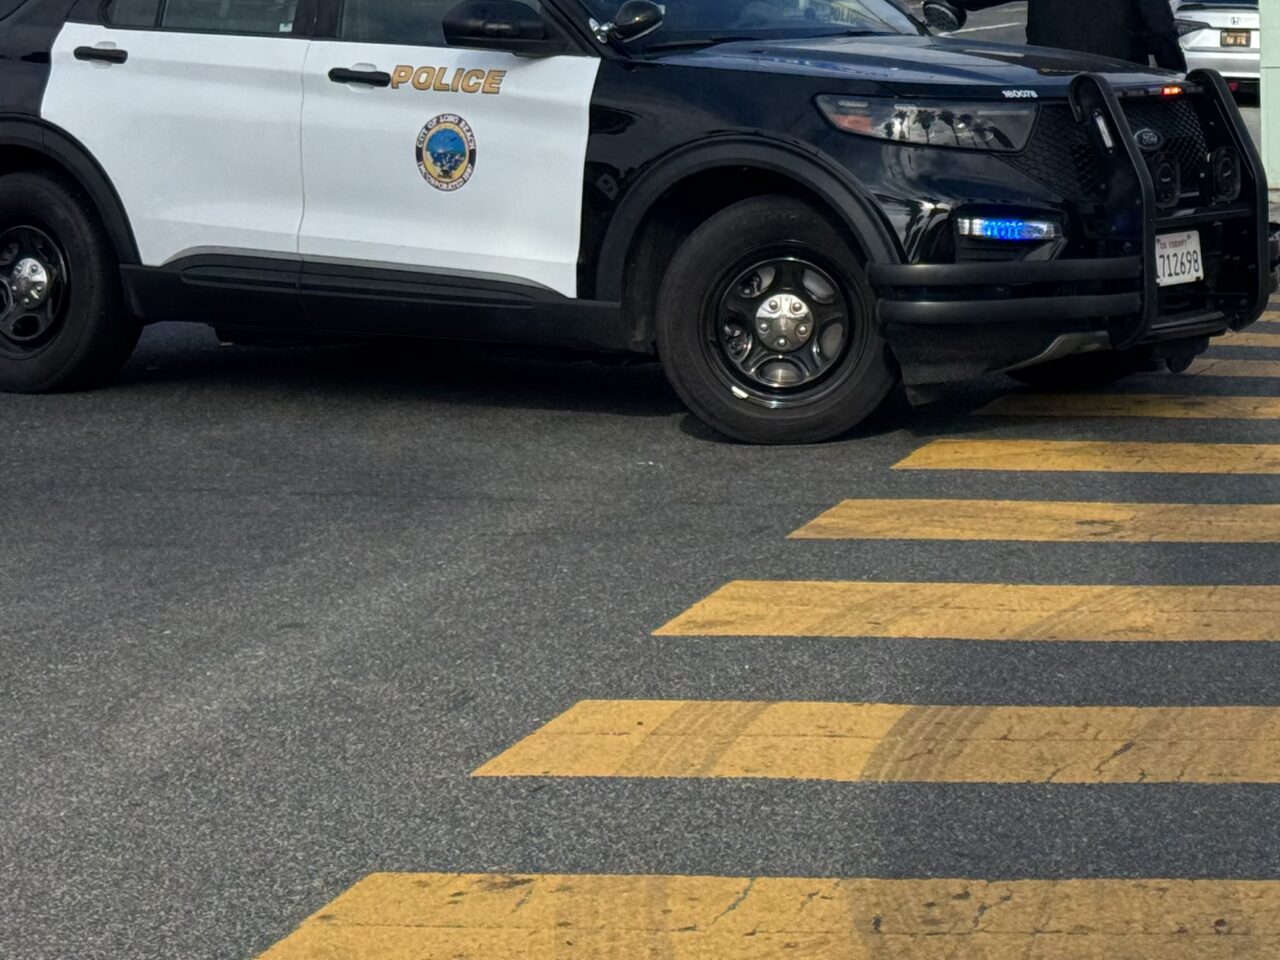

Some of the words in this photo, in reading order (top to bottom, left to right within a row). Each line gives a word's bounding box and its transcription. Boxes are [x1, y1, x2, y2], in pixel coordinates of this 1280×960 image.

[391, 64, 507, 95] POLICE
[439, 114, 460, 123] LONG
[460, 120, 477, 150] BEACH
